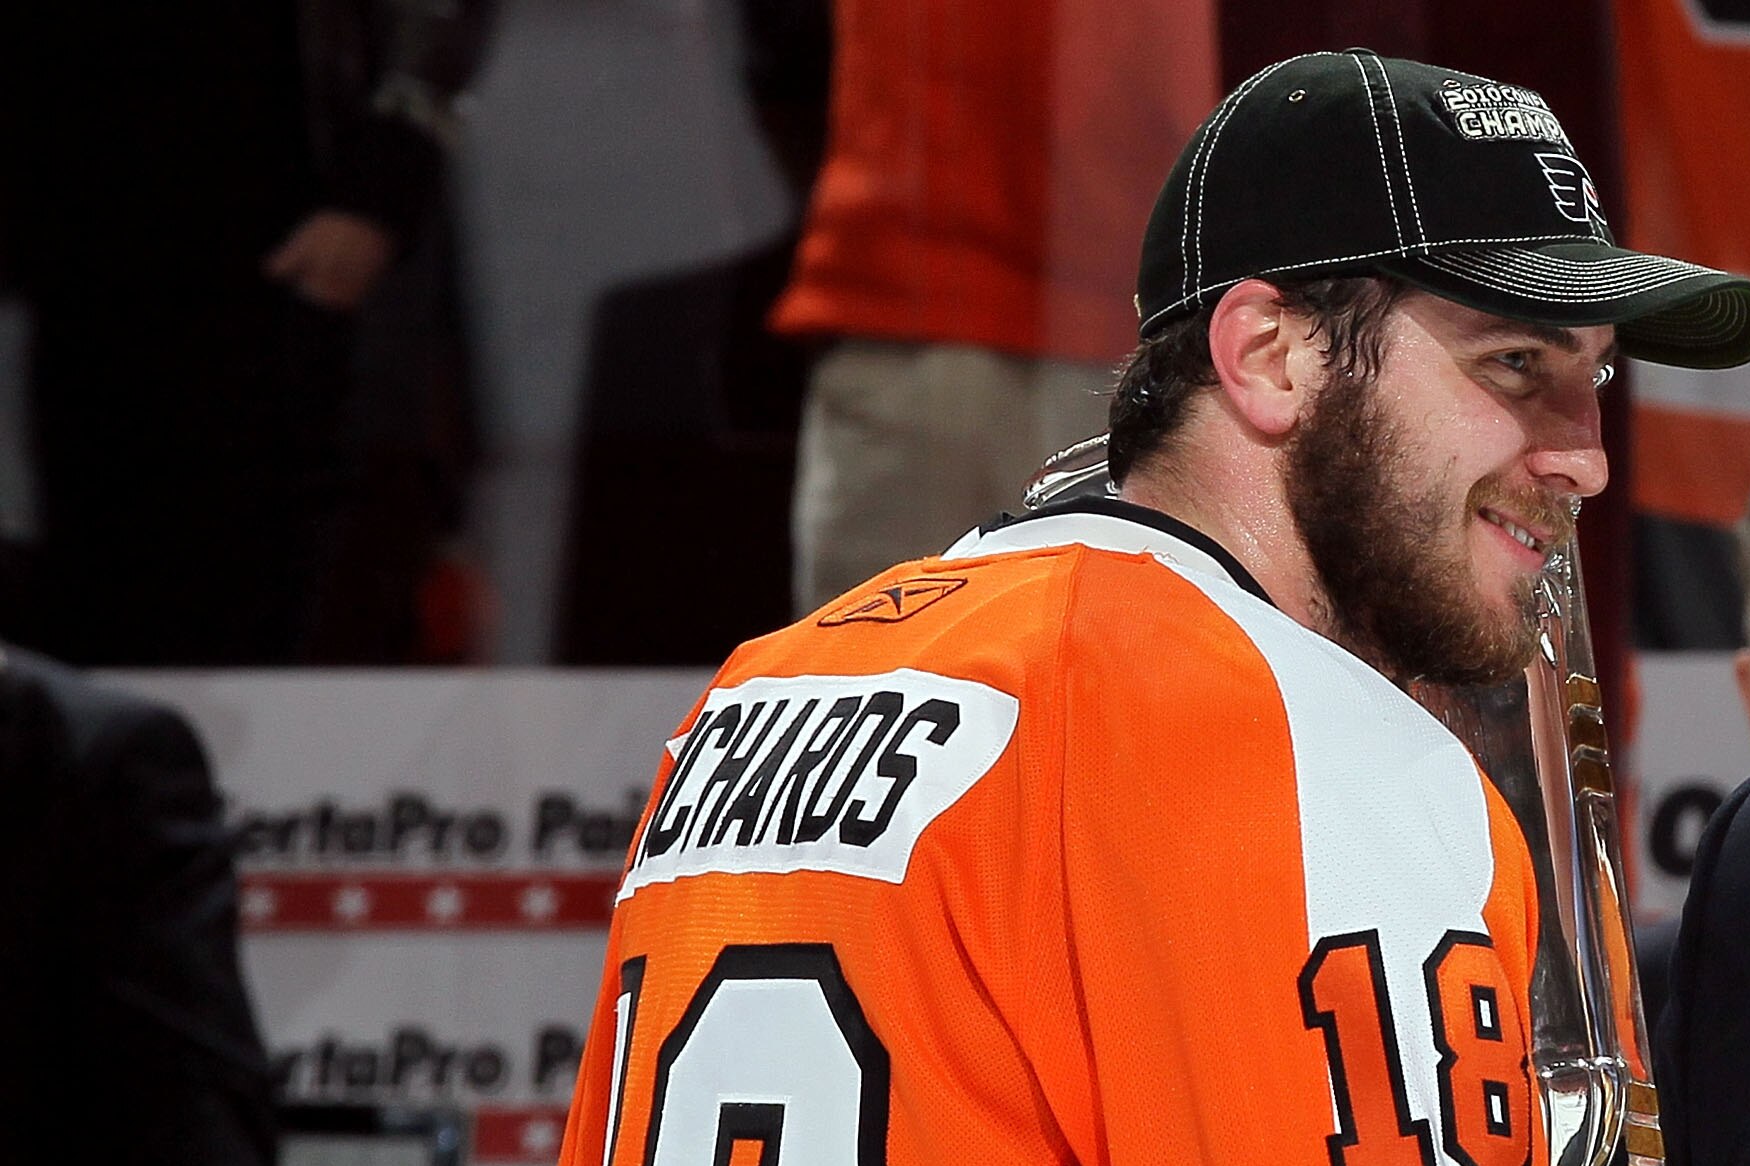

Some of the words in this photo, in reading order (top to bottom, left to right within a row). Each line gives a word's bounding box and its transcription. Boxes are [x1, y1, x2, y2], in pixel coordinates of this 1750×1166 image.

[1444, 84, 1502, 109] 2010
[1503, 86, 1550, 110] CONF
[1459, 109, 1563, 140] CHAMP
[630, 691, 960, 872] ICHARDS
[236, 787, 506, 854] ertaPro
[533, 784, 648, 854] Pai
[268, 1020, 508, 1089] rtaPro
